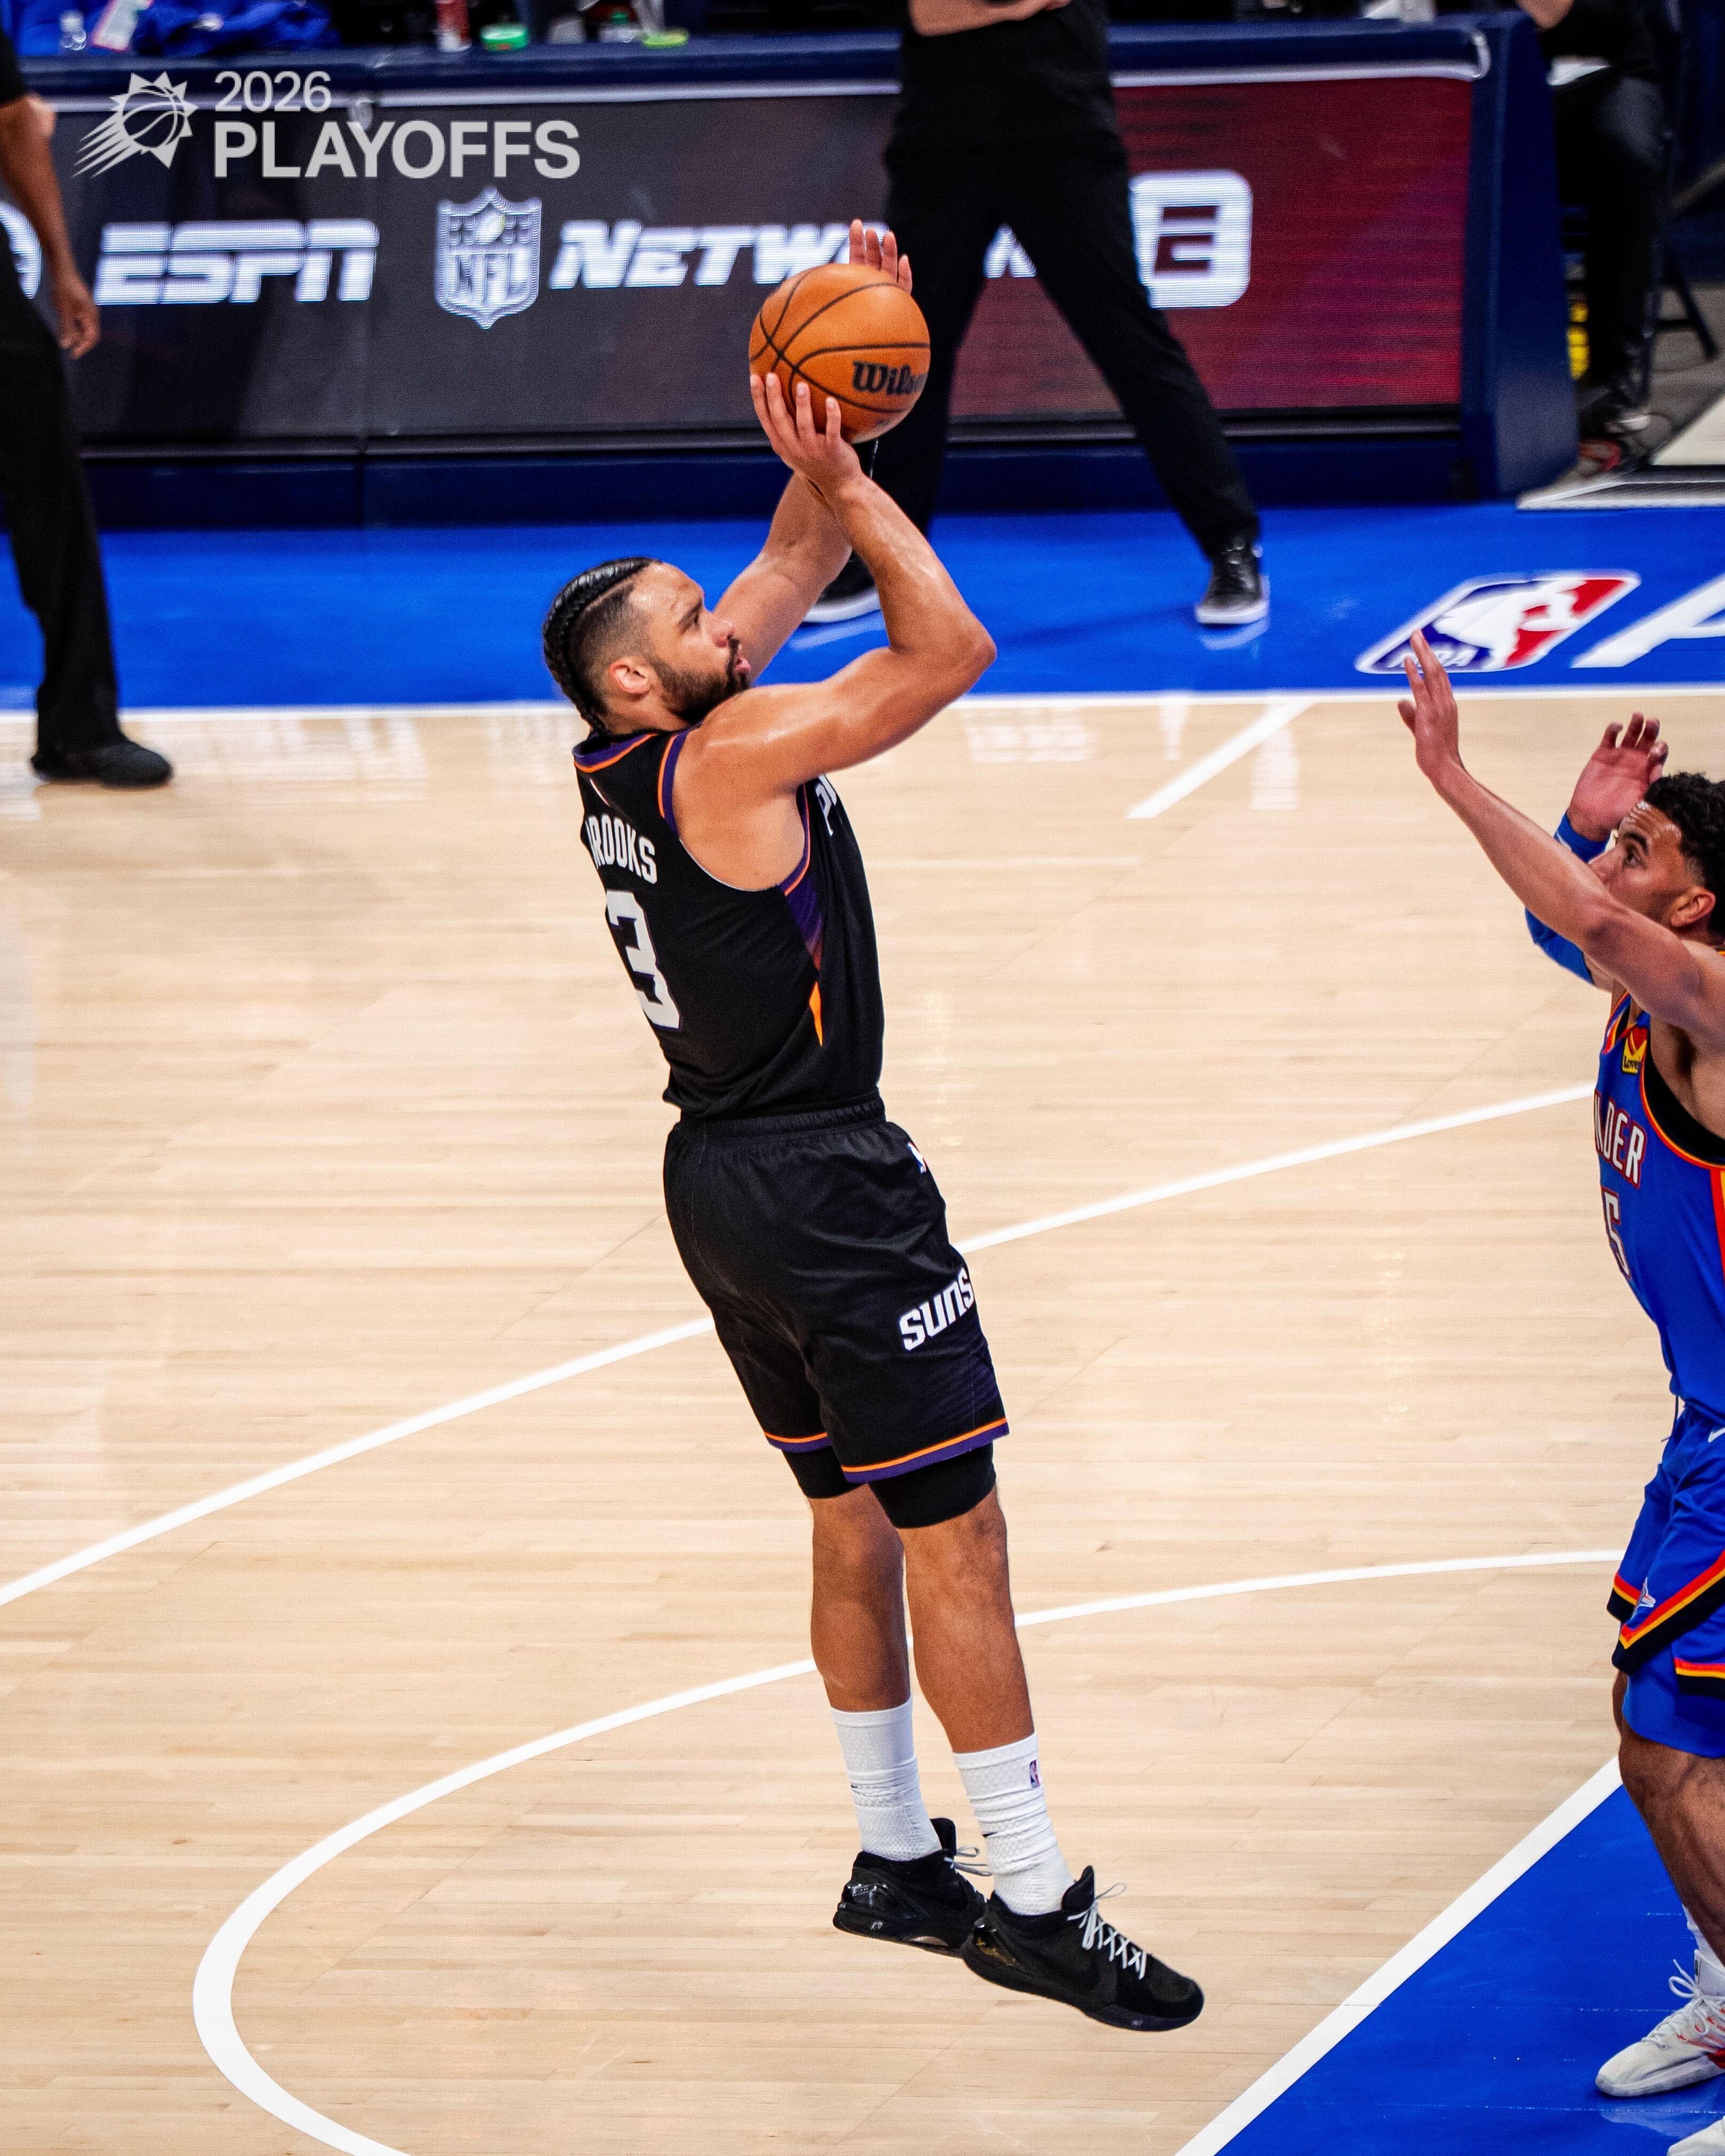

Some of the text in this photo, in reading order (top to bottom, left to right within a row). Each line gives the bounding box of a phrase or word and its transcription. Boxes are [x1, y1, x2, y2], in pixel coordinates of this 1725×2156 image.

[93, 219, 379, 305] ESPN
[585, 814, 657, 885] ROOKS
[605, 889, 682, 1031] 3
